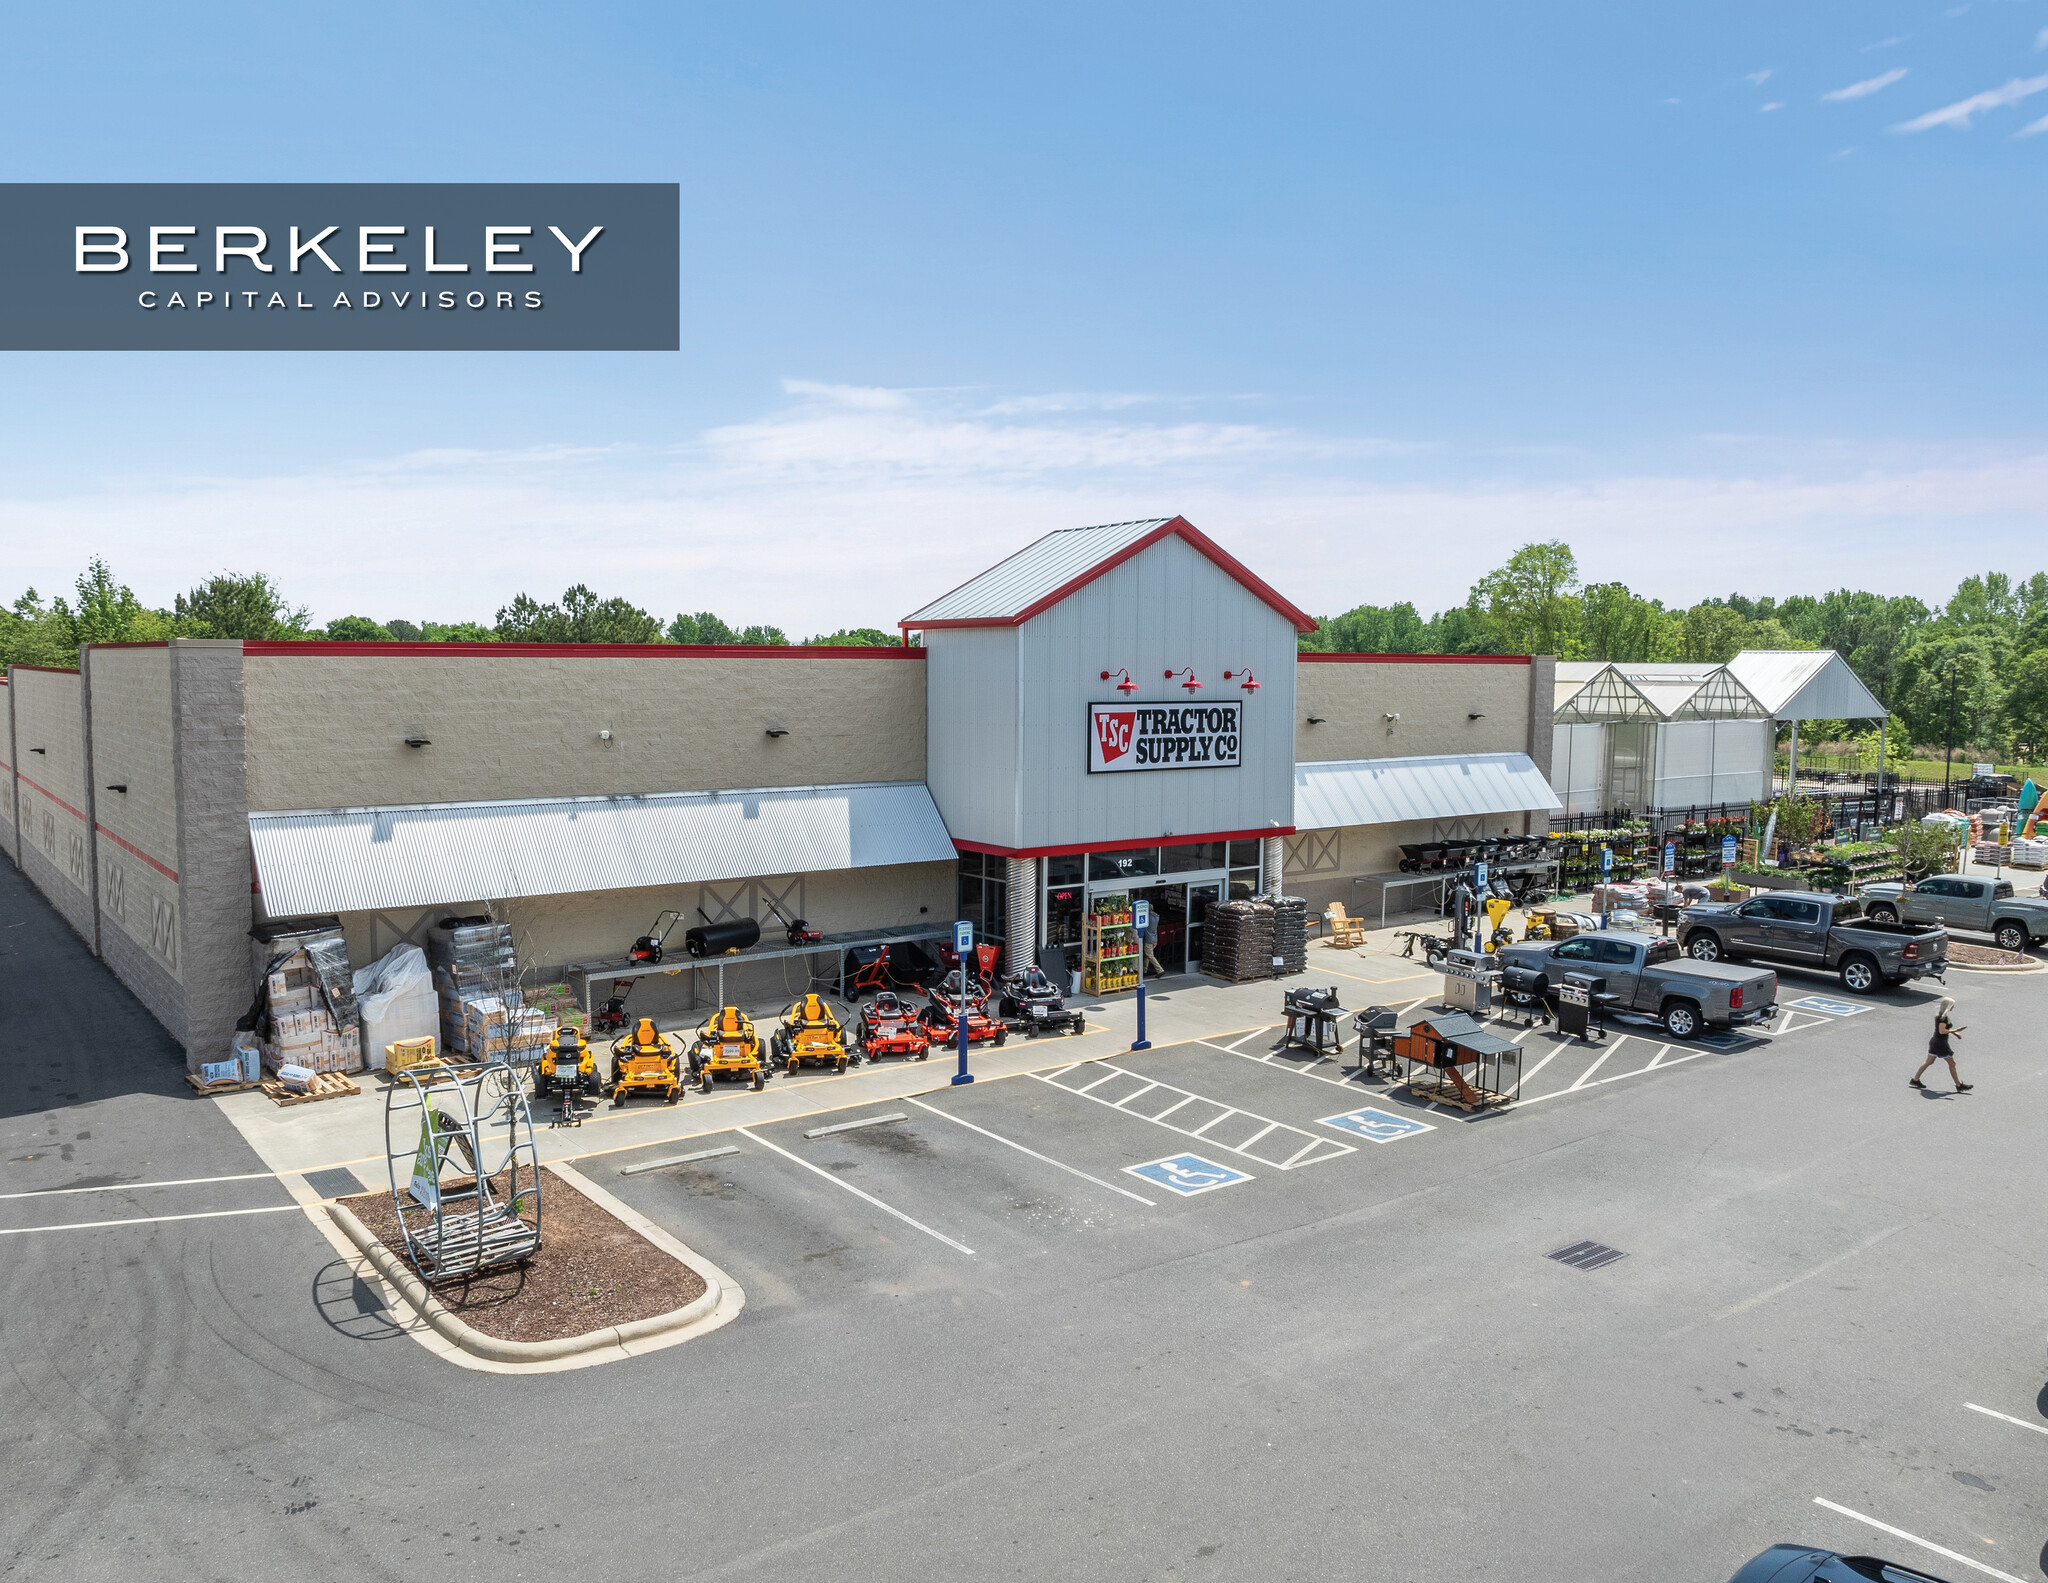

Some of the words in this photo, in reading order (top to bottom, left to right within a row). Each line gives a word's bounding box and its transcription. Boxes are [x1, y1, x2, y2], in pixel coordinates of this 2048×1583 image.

[1100, 714, 1128, 753] TSC
[1136, 708, 1237, 735] TRACTOR
[1135, 736, 1213, 764] SUPPLY
[1118, 858, 1133, 868] 192
[1056, 891, 1072, 900] OPEN
